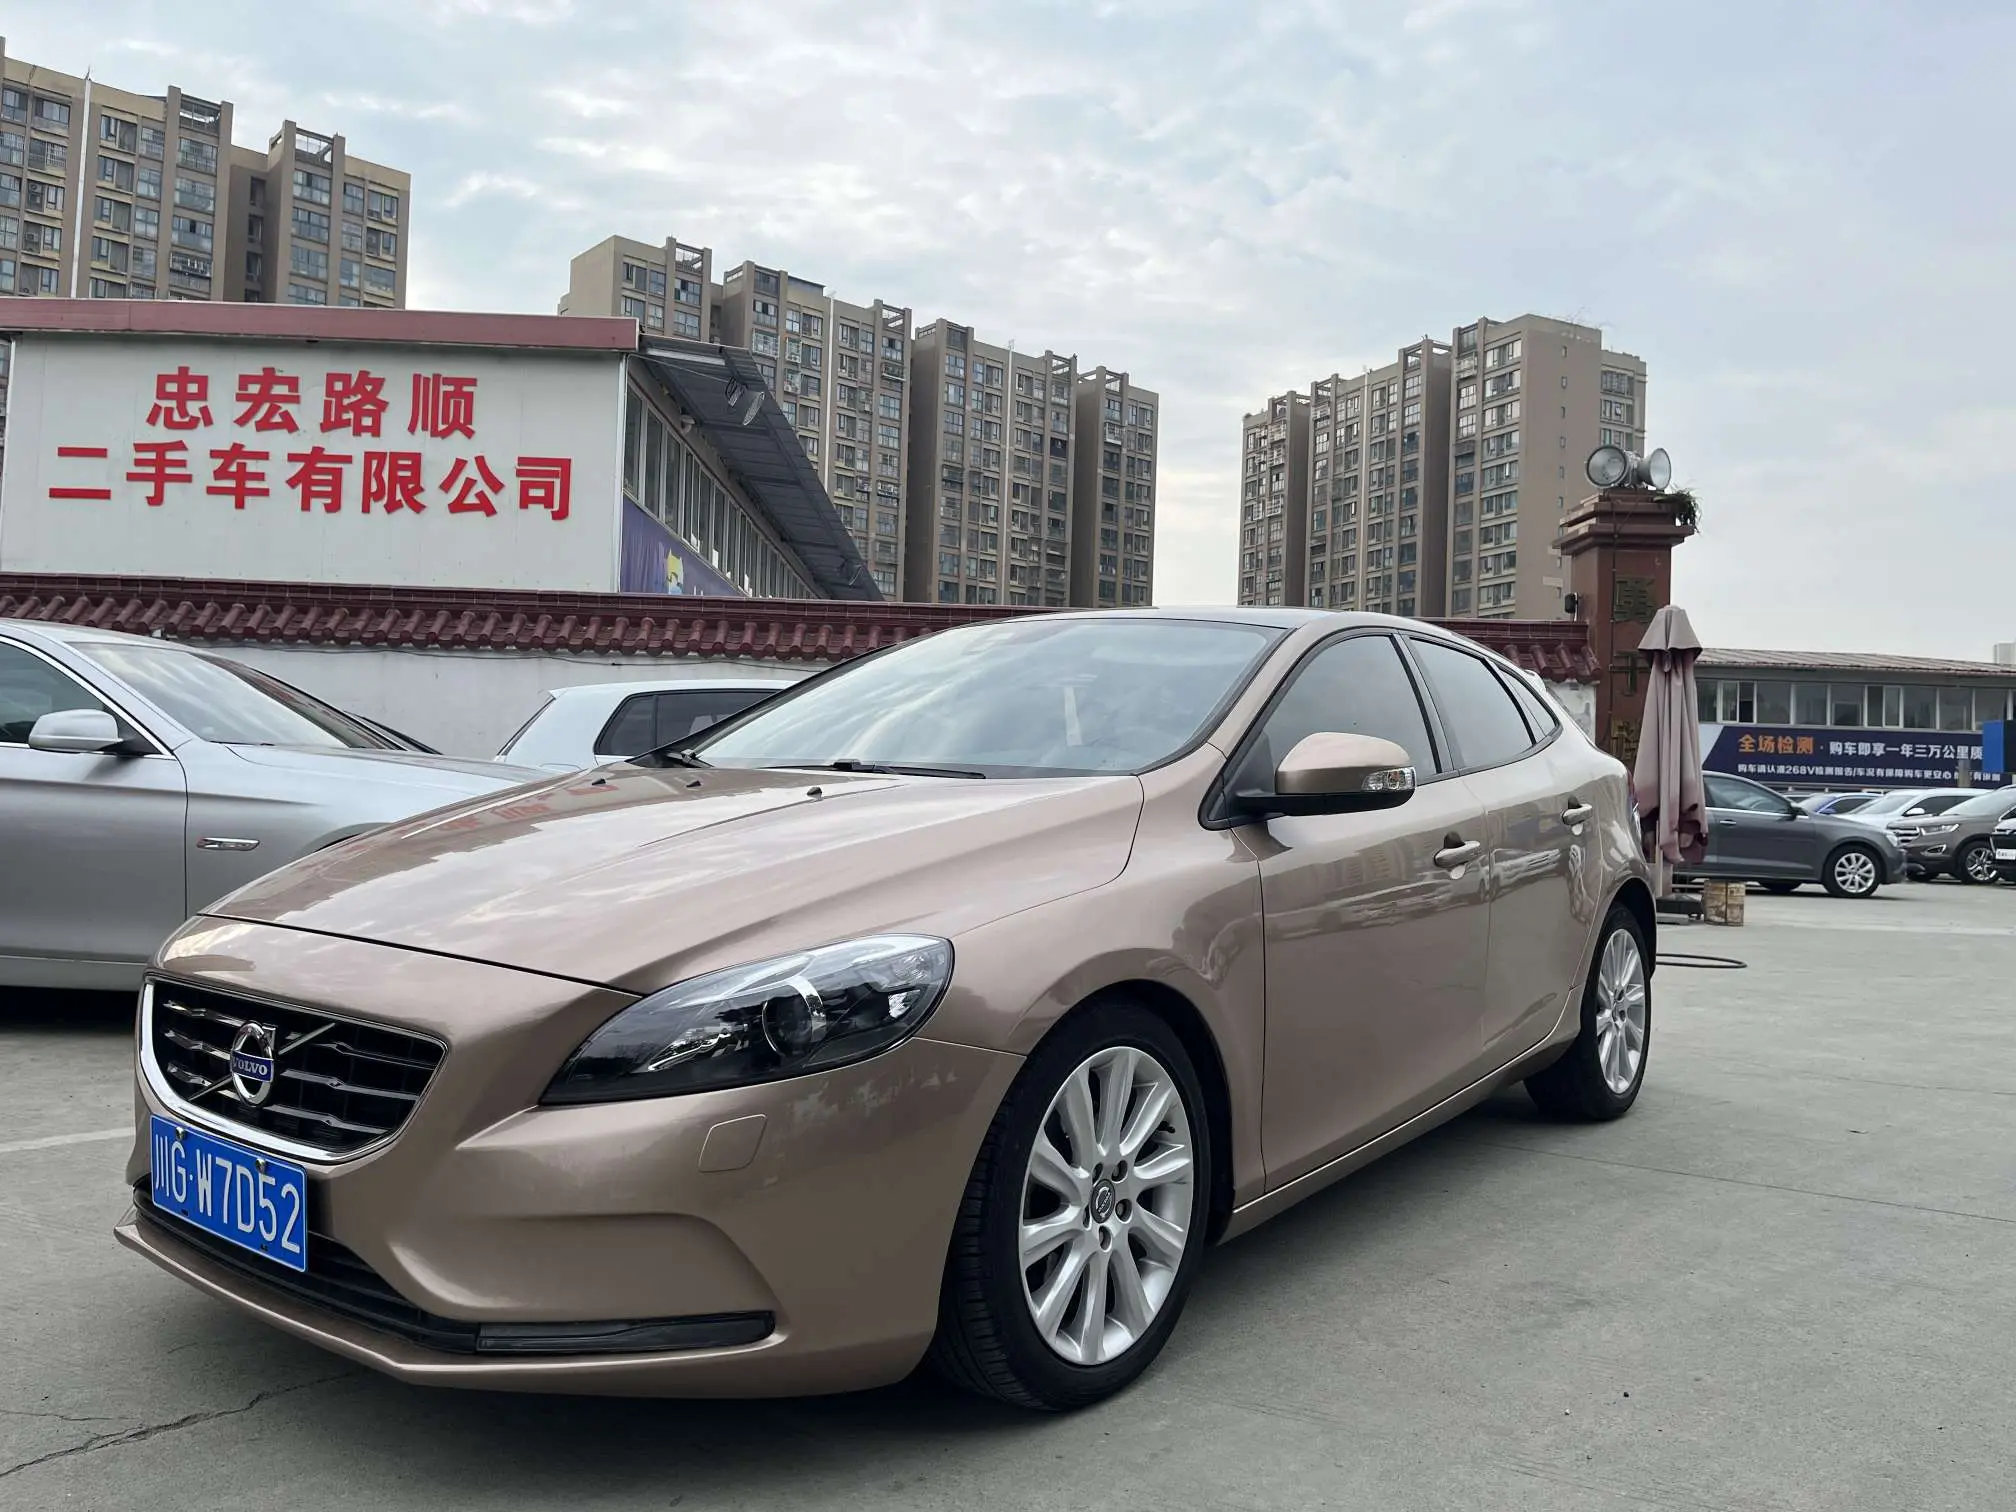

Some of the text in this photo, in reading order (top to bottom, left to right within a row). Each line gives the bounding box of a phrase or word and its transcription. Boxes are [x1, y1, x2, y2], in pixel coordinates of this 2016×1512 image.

[147, 366, 478, 439] 忠宏路顺
[49, 440, 572, 521] 二手车有限公司
[1738, 734, 1814, 754] 全场检测
[232, 1056, 268, 1076] VOLVO
